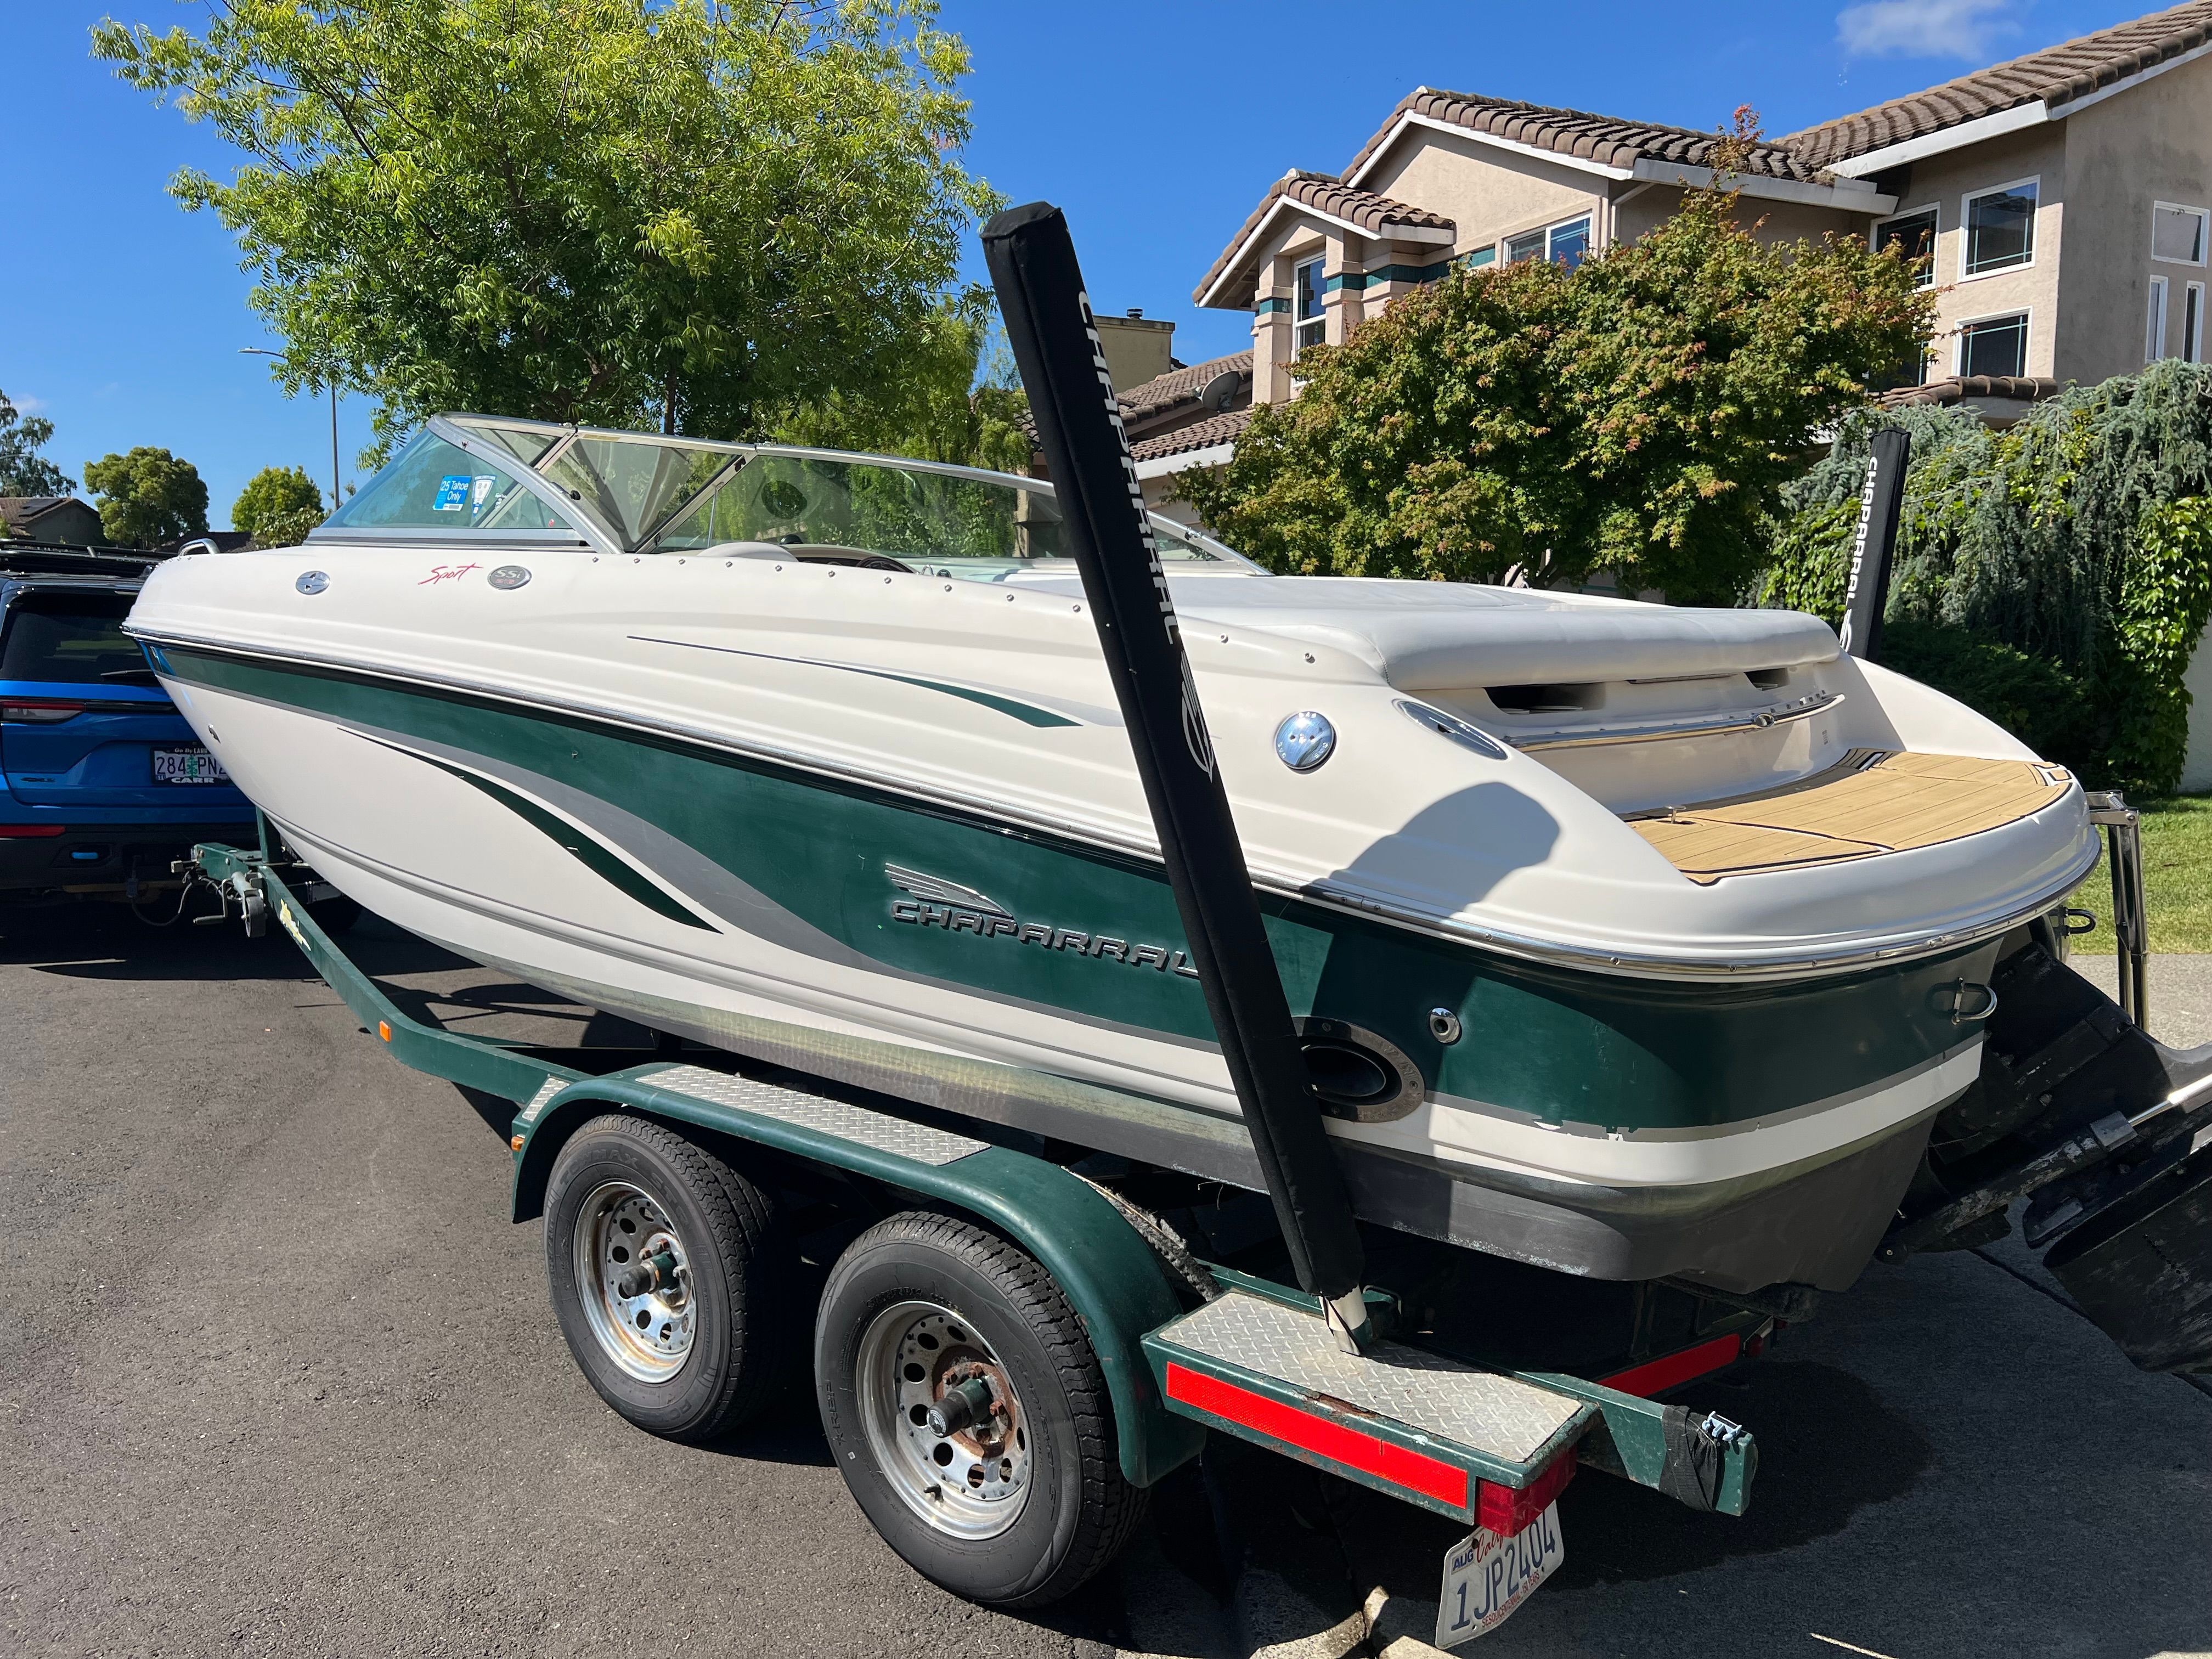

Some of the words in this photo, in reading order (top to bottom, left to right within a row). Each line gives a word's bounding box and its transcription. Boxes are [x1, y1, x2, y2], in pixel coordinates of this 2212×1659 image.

[1079, 291, 1178, 645] CHAPARRAL
[447, 490, 461, 503] Only
[451, 480, 469, 490] Tahoe
[1846, 456, 1877, 606] CHAPARRAL
[418, 562, 483, 585] Sport
[495, 569, 523, 578] SSi
[156, 757, 186, 774] 284
[891, 899, 1200, 979] CHAPARRAL
[560, 1149, 639, 1186] TOWMAX
[1451, 1510, 1555, 1631] 1JP2404
[1453, 1549, 1474, 1571] AUG
